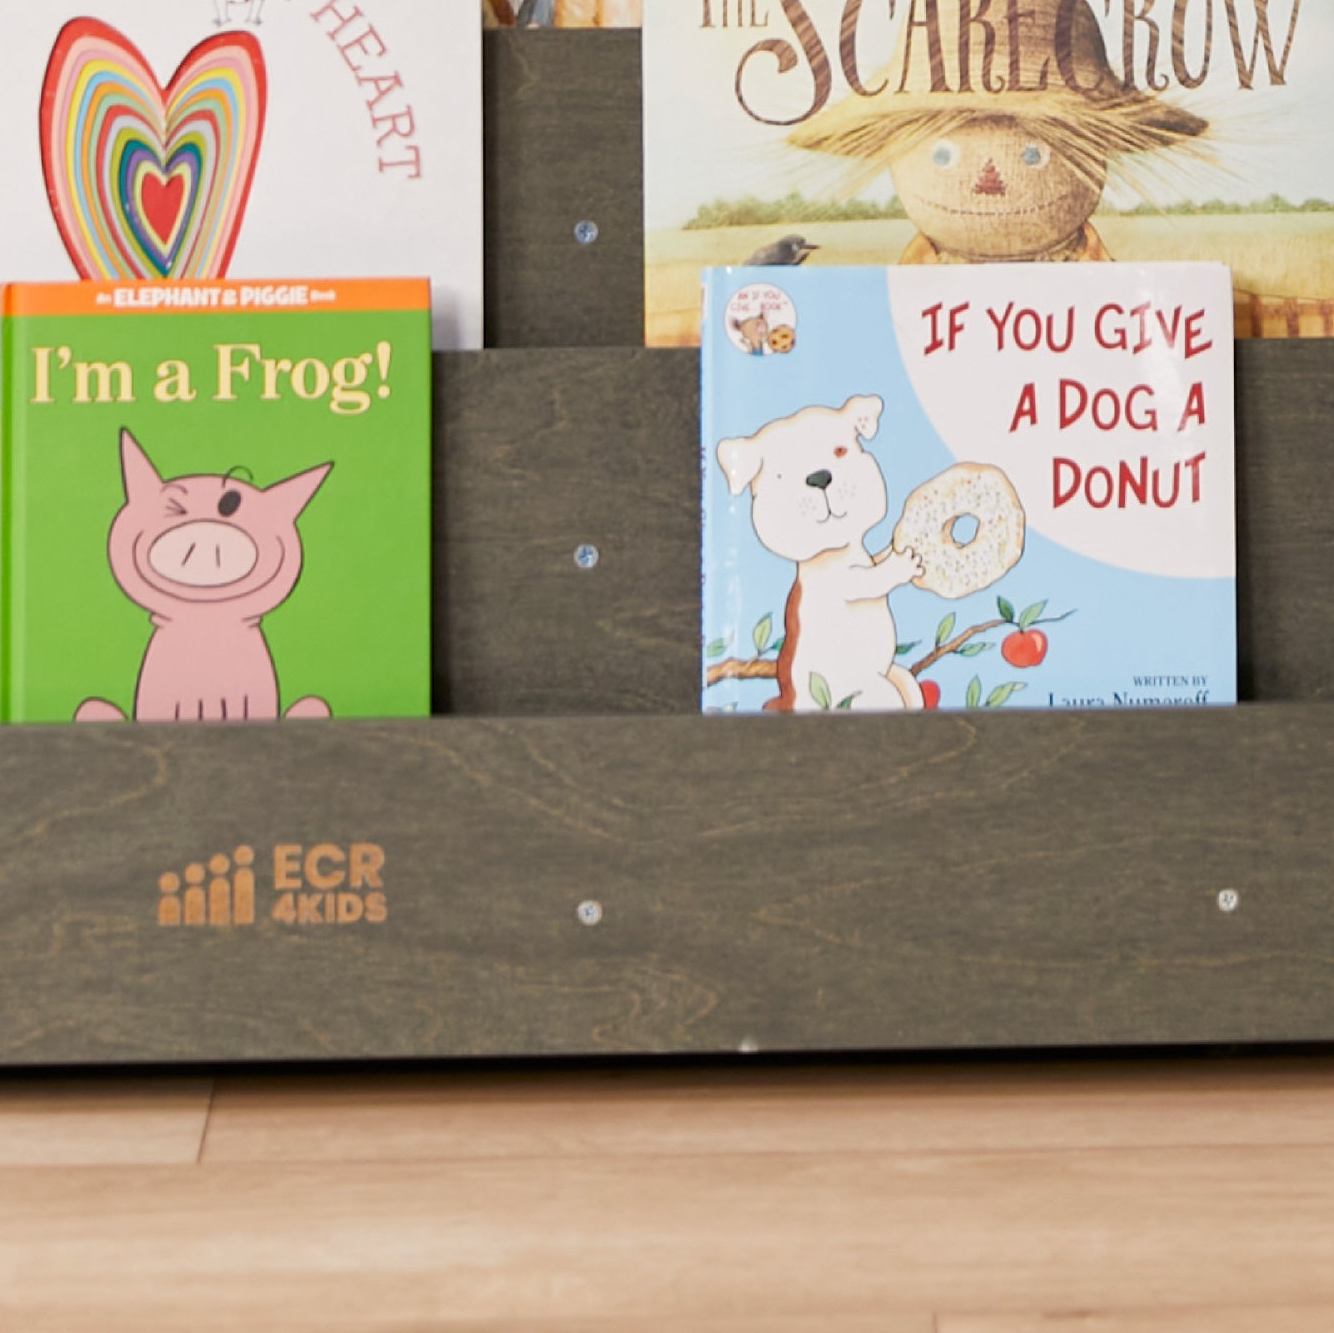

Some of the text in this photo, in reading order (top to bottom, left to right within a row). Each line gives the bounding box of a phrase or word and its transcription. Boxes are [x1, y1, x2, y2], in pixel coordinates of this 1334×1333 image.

[114, 287, 221, 307] ELEPHANT
[222, 288, 237, 306] &
[240, 285, 308, 306] PIGGIE
[921, 301, 1213, 359] IF YOU GIVE
[30, 340, 392, 415] I'm a Frog!
[1009, 378, 1206, 433] A DOG A
[1053, 451, 1207, 509] DONUT
[1133, 675, 1208, 687] WRITTEN BY
[273, 842, 386, 890] ECR
[270, 891, 388, 925] 4KIDS
